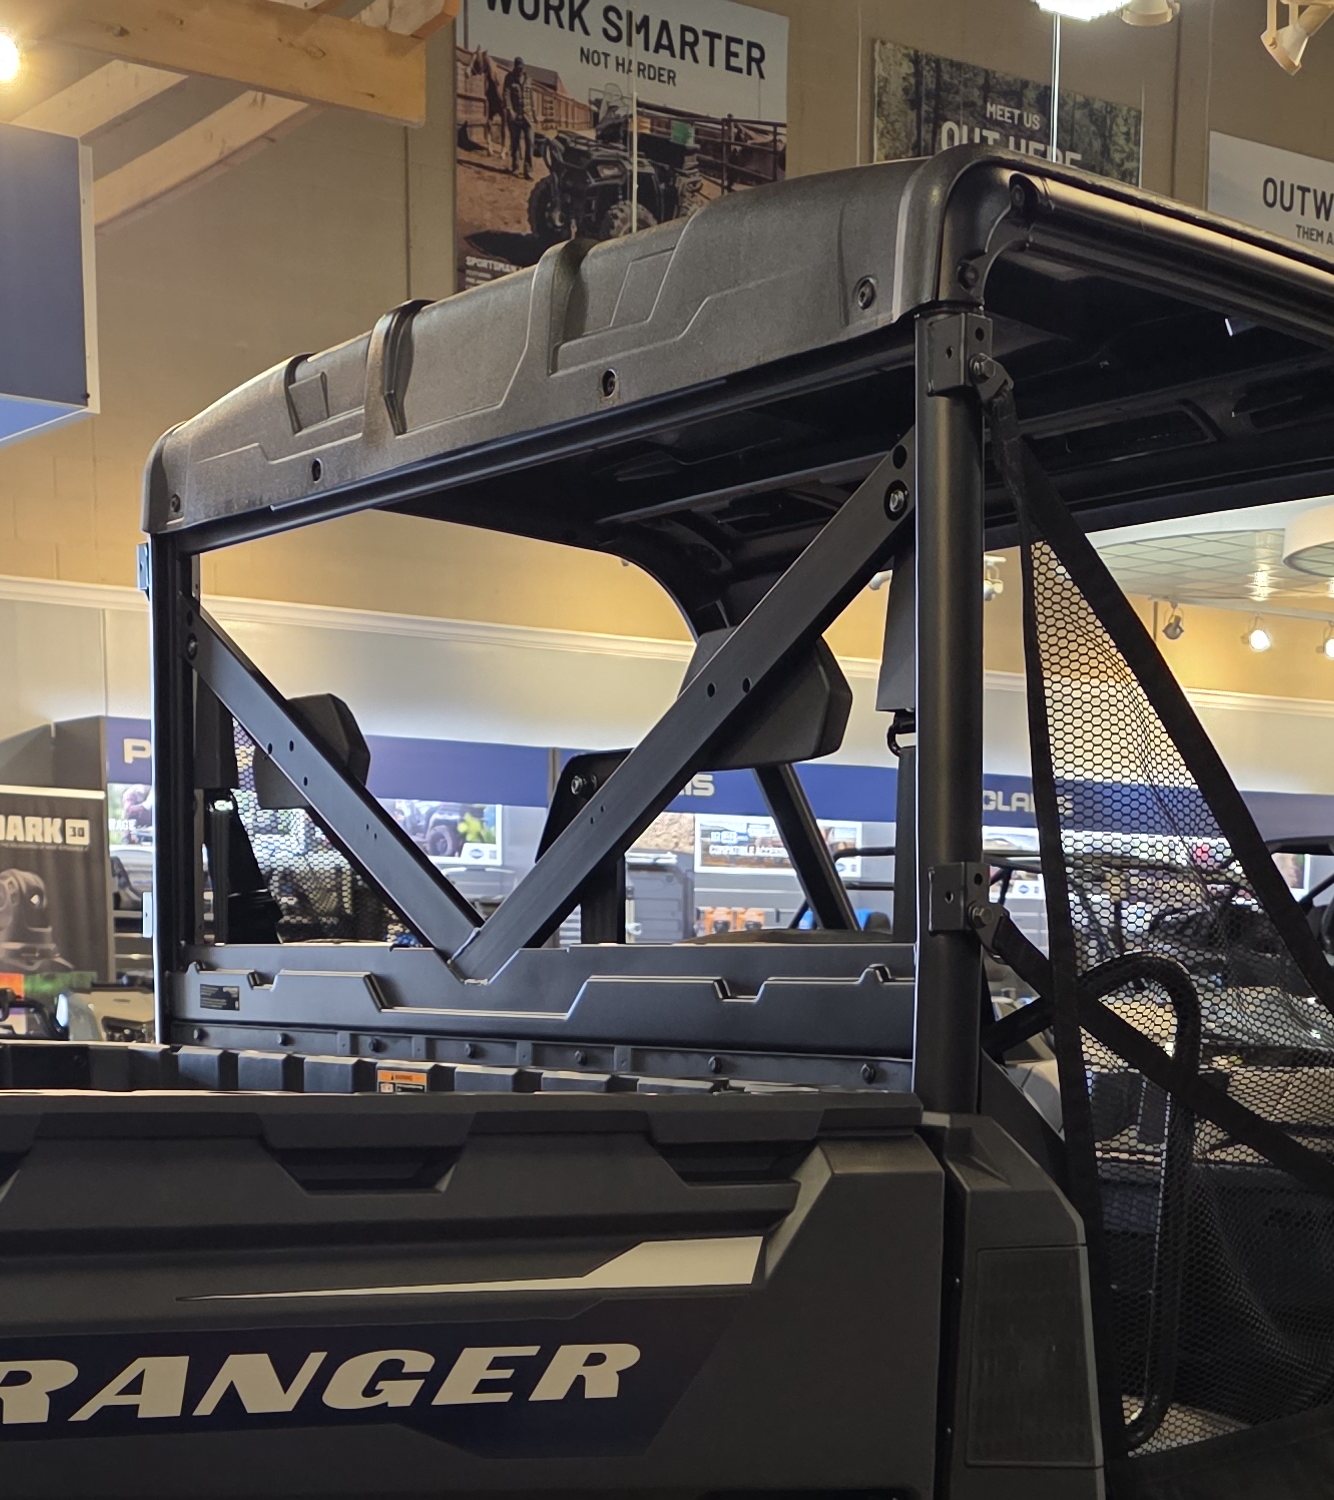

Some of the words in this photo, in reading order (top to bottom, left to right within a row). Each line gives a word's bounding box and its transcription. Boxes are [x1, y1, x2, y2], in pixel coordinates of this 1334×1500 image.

[602, 5, 765, 80] SMARTER
[579, 46, 611, 69] NOT
[986, 102, 1021, 125] MEET
[1023, 112, 1041, 130] US
[1295, 224, 1324, 244] THEM
